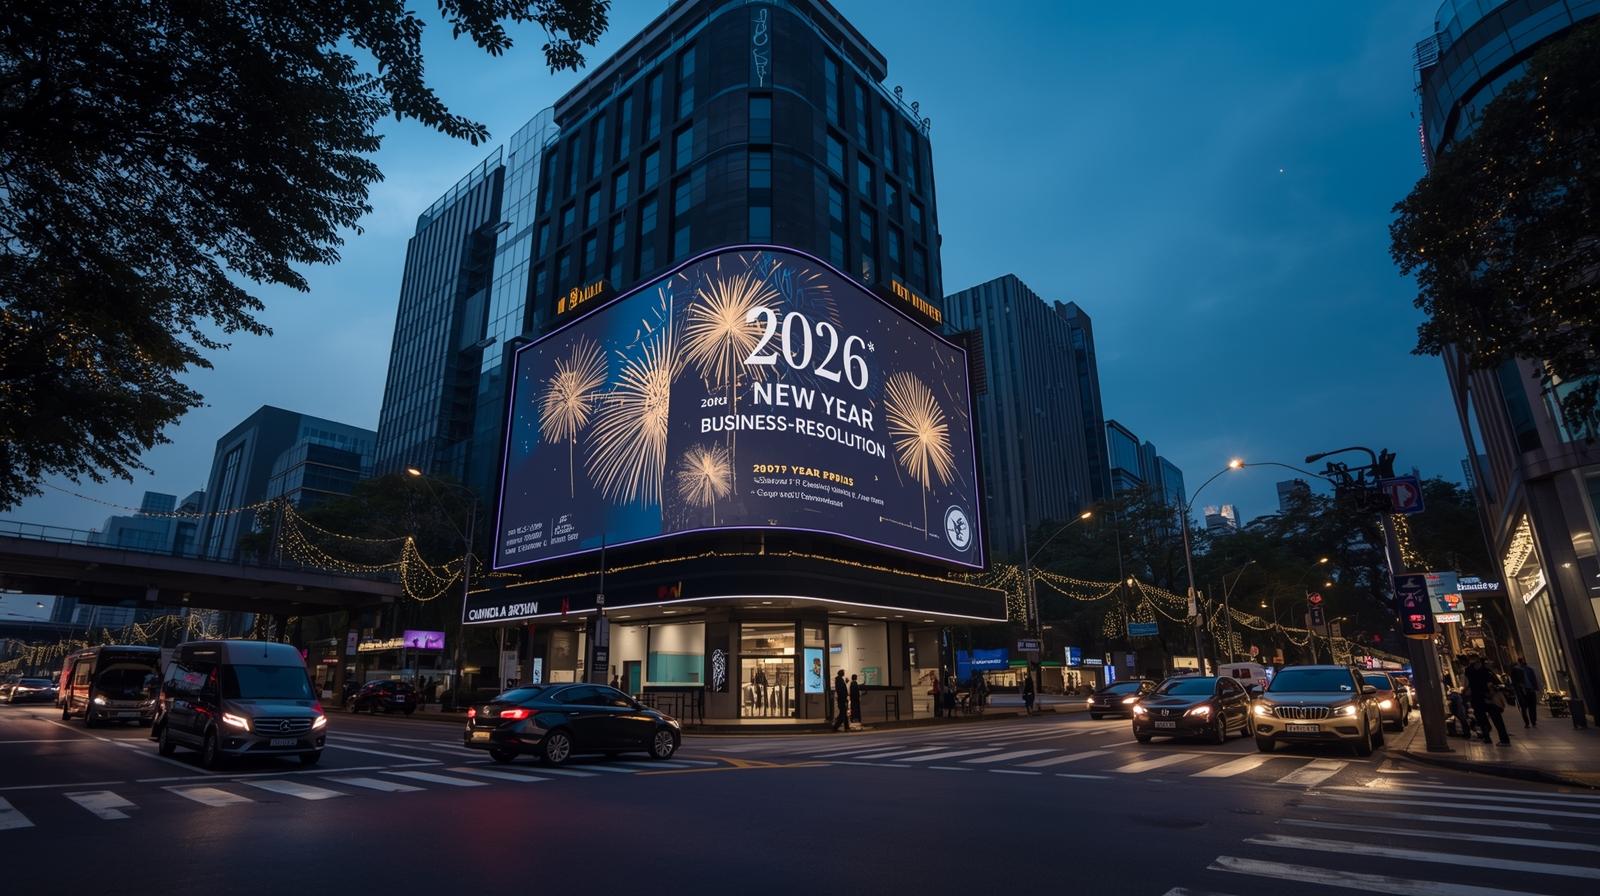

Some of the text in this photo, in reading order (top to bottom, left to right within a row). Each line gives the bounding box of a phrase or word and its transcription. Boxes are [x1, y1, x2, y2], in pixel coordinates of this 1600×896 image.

[753, 381, 874, 431] NEW YEAR
[701, 414, 887, 460] BUSINESS-RESOLUTION
[791, 465, 821, 479] YEAR
